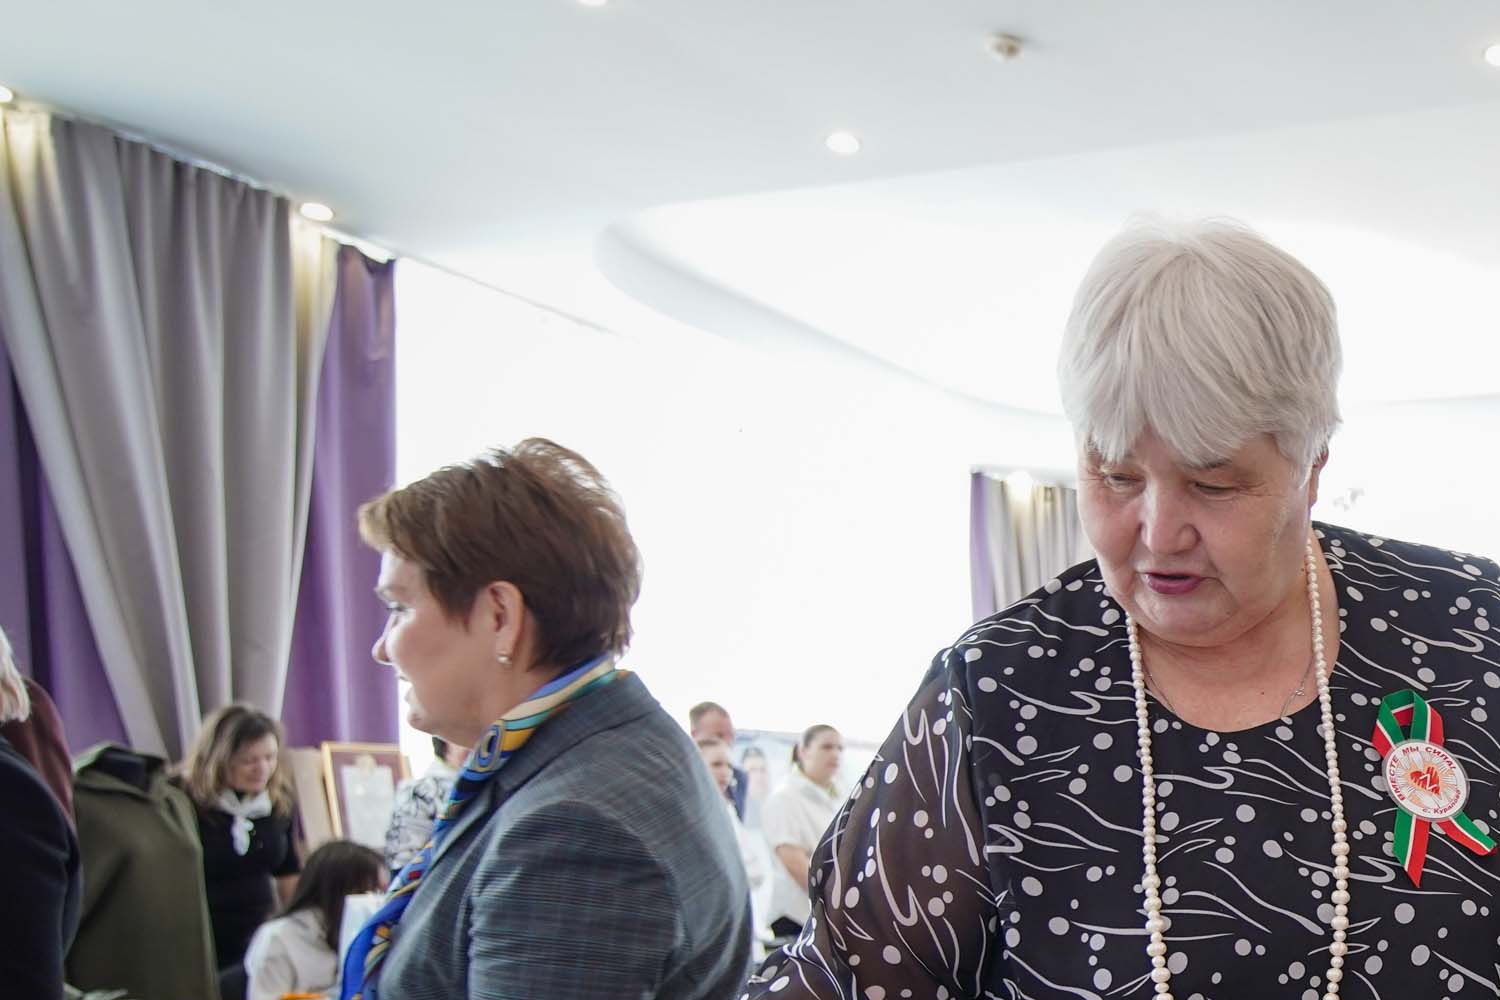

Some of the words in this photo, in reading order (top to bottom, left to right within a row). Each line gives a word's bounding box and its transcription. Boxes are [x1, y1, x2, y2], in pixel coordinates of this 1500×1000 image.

[1389, 755, 1406, 801] ВМЕСТЕ
[1401, 746, 1419, 754] МЫ
[1424, 746, 1457, 770] СИЛА!
